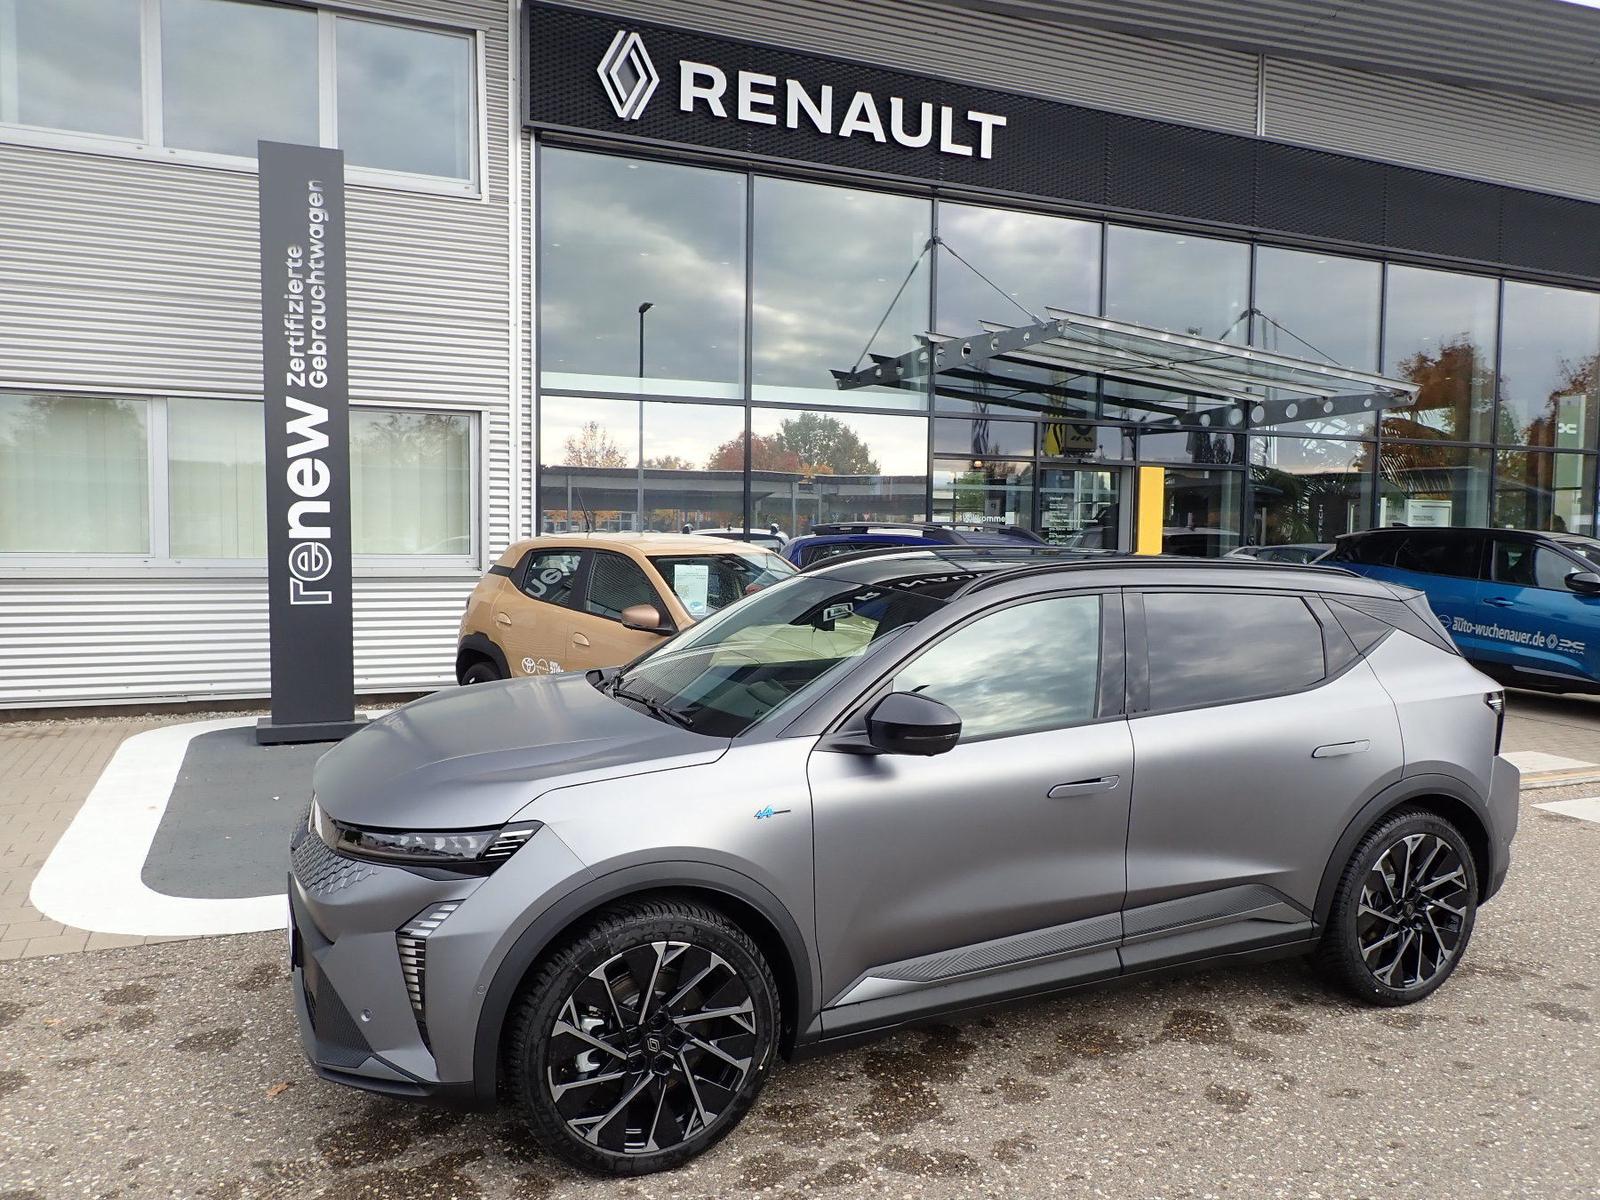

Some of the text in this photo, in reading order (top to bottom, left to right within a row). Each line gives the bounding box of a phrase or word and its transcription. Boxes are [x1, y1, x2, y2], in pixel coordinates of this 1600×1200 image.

[679, 60, 1007, 159] RENAULT
[284, 245, 306, 388] Zertifizierte
[306, 179, 329, 389] Gebrauchtwagen
[285, 396, 333, 605] renew
[1452, 619, 1546, 647] auto-wuchenauer.de
